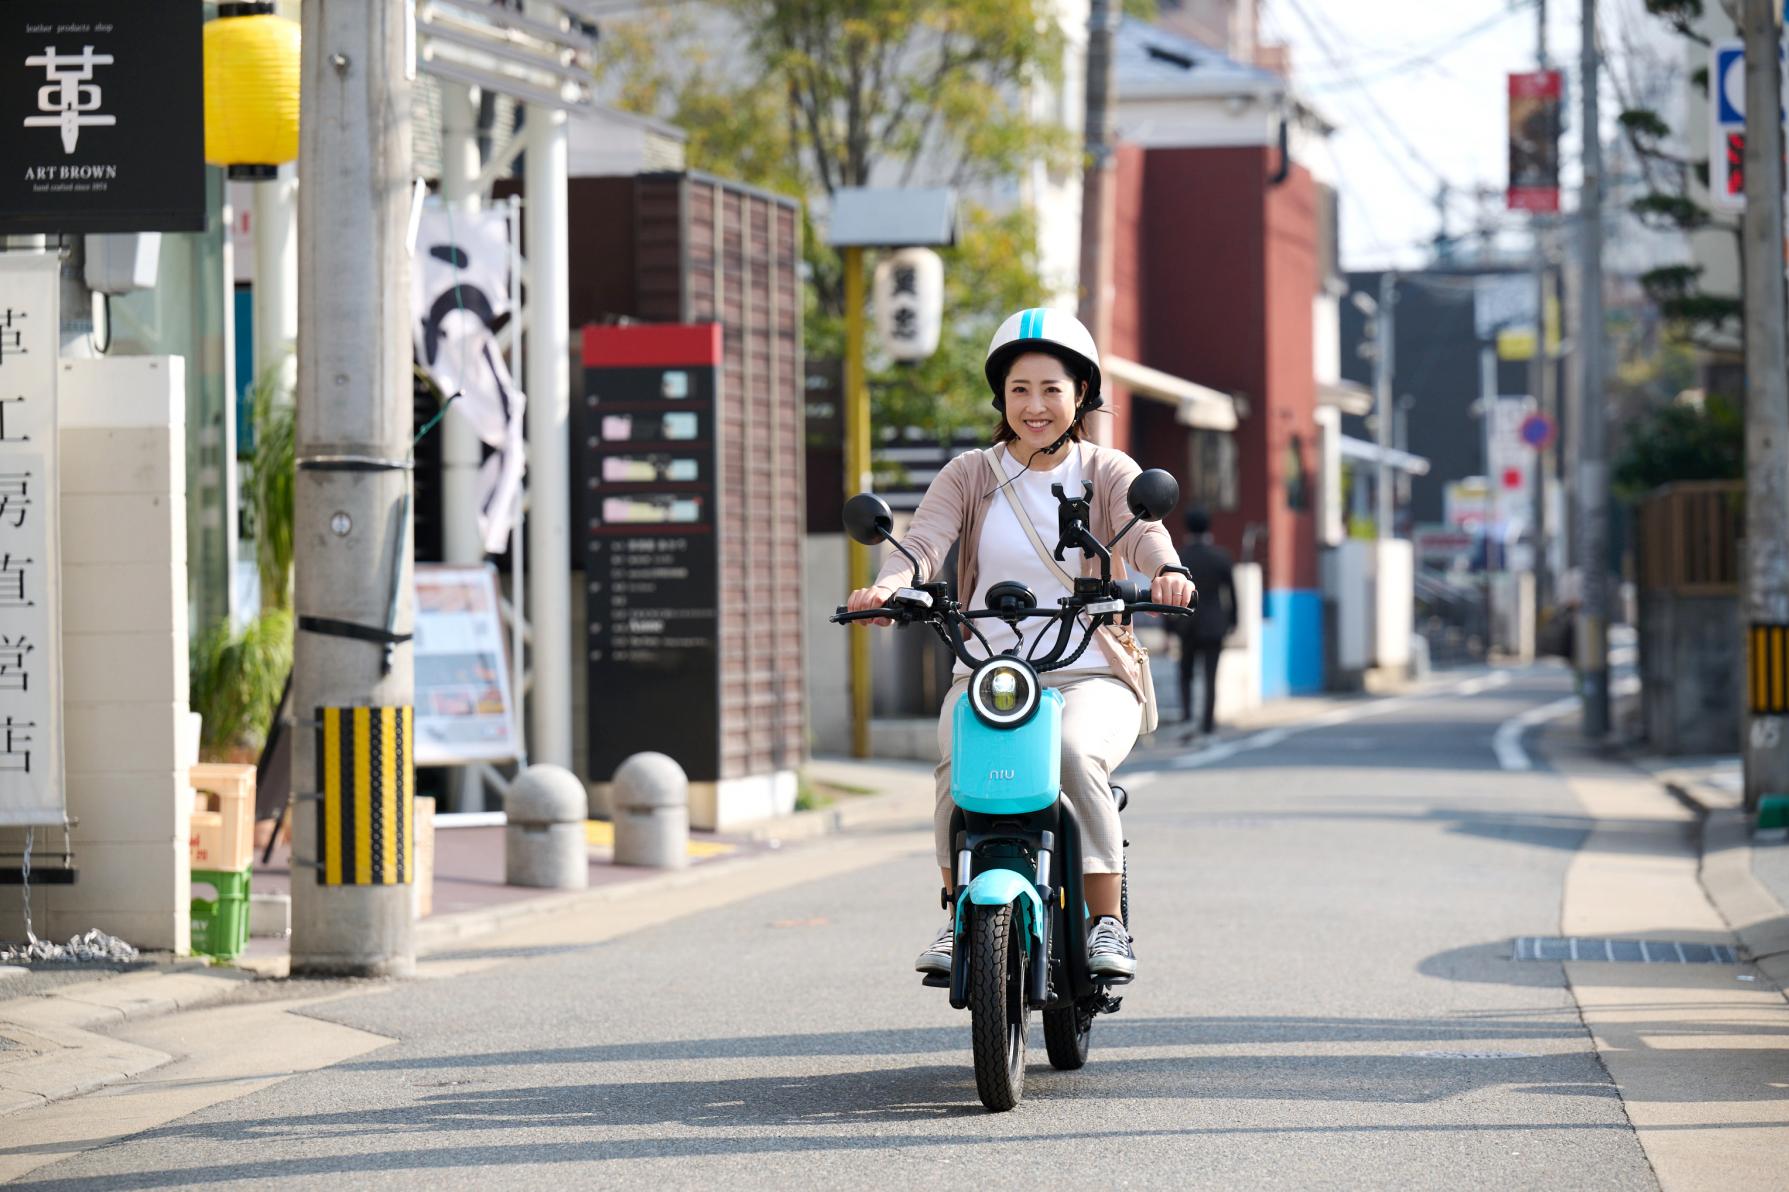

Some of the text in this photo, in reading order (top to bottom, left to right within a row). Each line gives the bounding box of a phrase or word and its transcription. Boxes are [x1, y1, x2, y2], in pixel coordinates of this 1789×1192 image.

[56, 22, 90, 35] products
[95, 22, 114, 33] shop
[25, 165, 117, 180] ART BROWN
